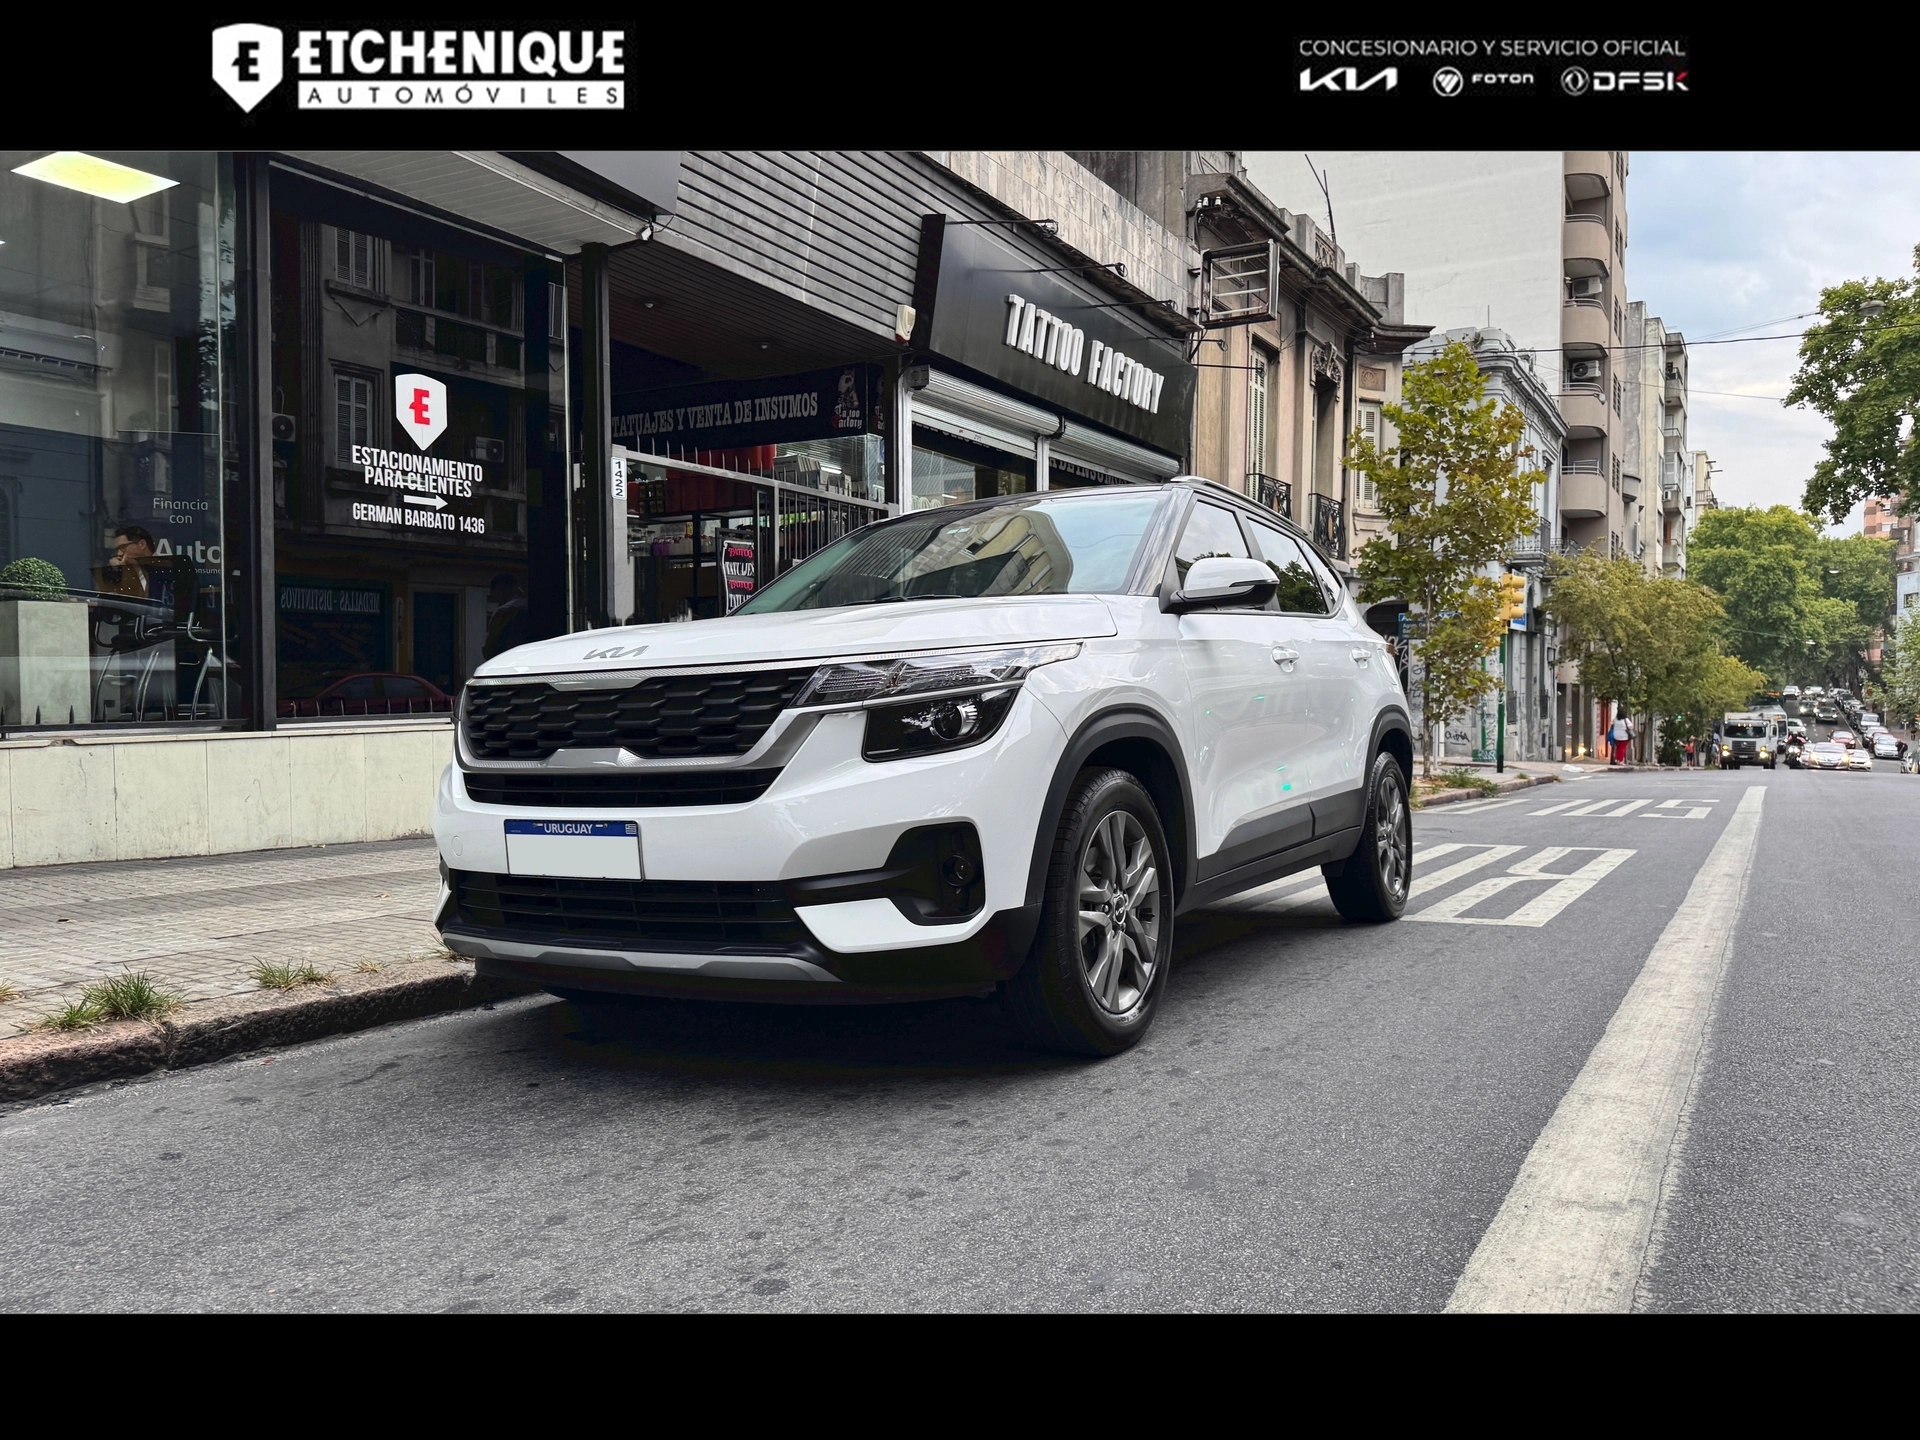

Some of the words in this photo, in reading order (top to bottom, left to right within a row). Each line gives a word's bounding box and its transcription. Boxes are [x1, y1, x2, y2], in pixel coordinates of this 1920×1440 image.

[1005, 294, 1084, 376] TATTOO
[1087, 340, 1165, 414] FACTORY
[612, 409, 674, 438] TATUAJES
[676, 408, 685, 430] Y
[687, 402, 732, 429] VENTA
[734, 400, 752, 424] DE
[755, 391, 818, 421] INSUMOS
[352, 444, 483, 482] ESTACIONAMIENTO
[614, 461, 624, 497] 1422
[364, 466, 404, 489] PARA
[407, 472, 472, 498] CLIENTES
[153, 497, 209, 511] Financia
[169, 514, 193, 524] con
[352, 502, 402, 525] GERMAN
[404, 509, 455, 531] BARBATO
[458, 516, 485, 534] 1436
[543, 823, 594, 834] URUGUAY
